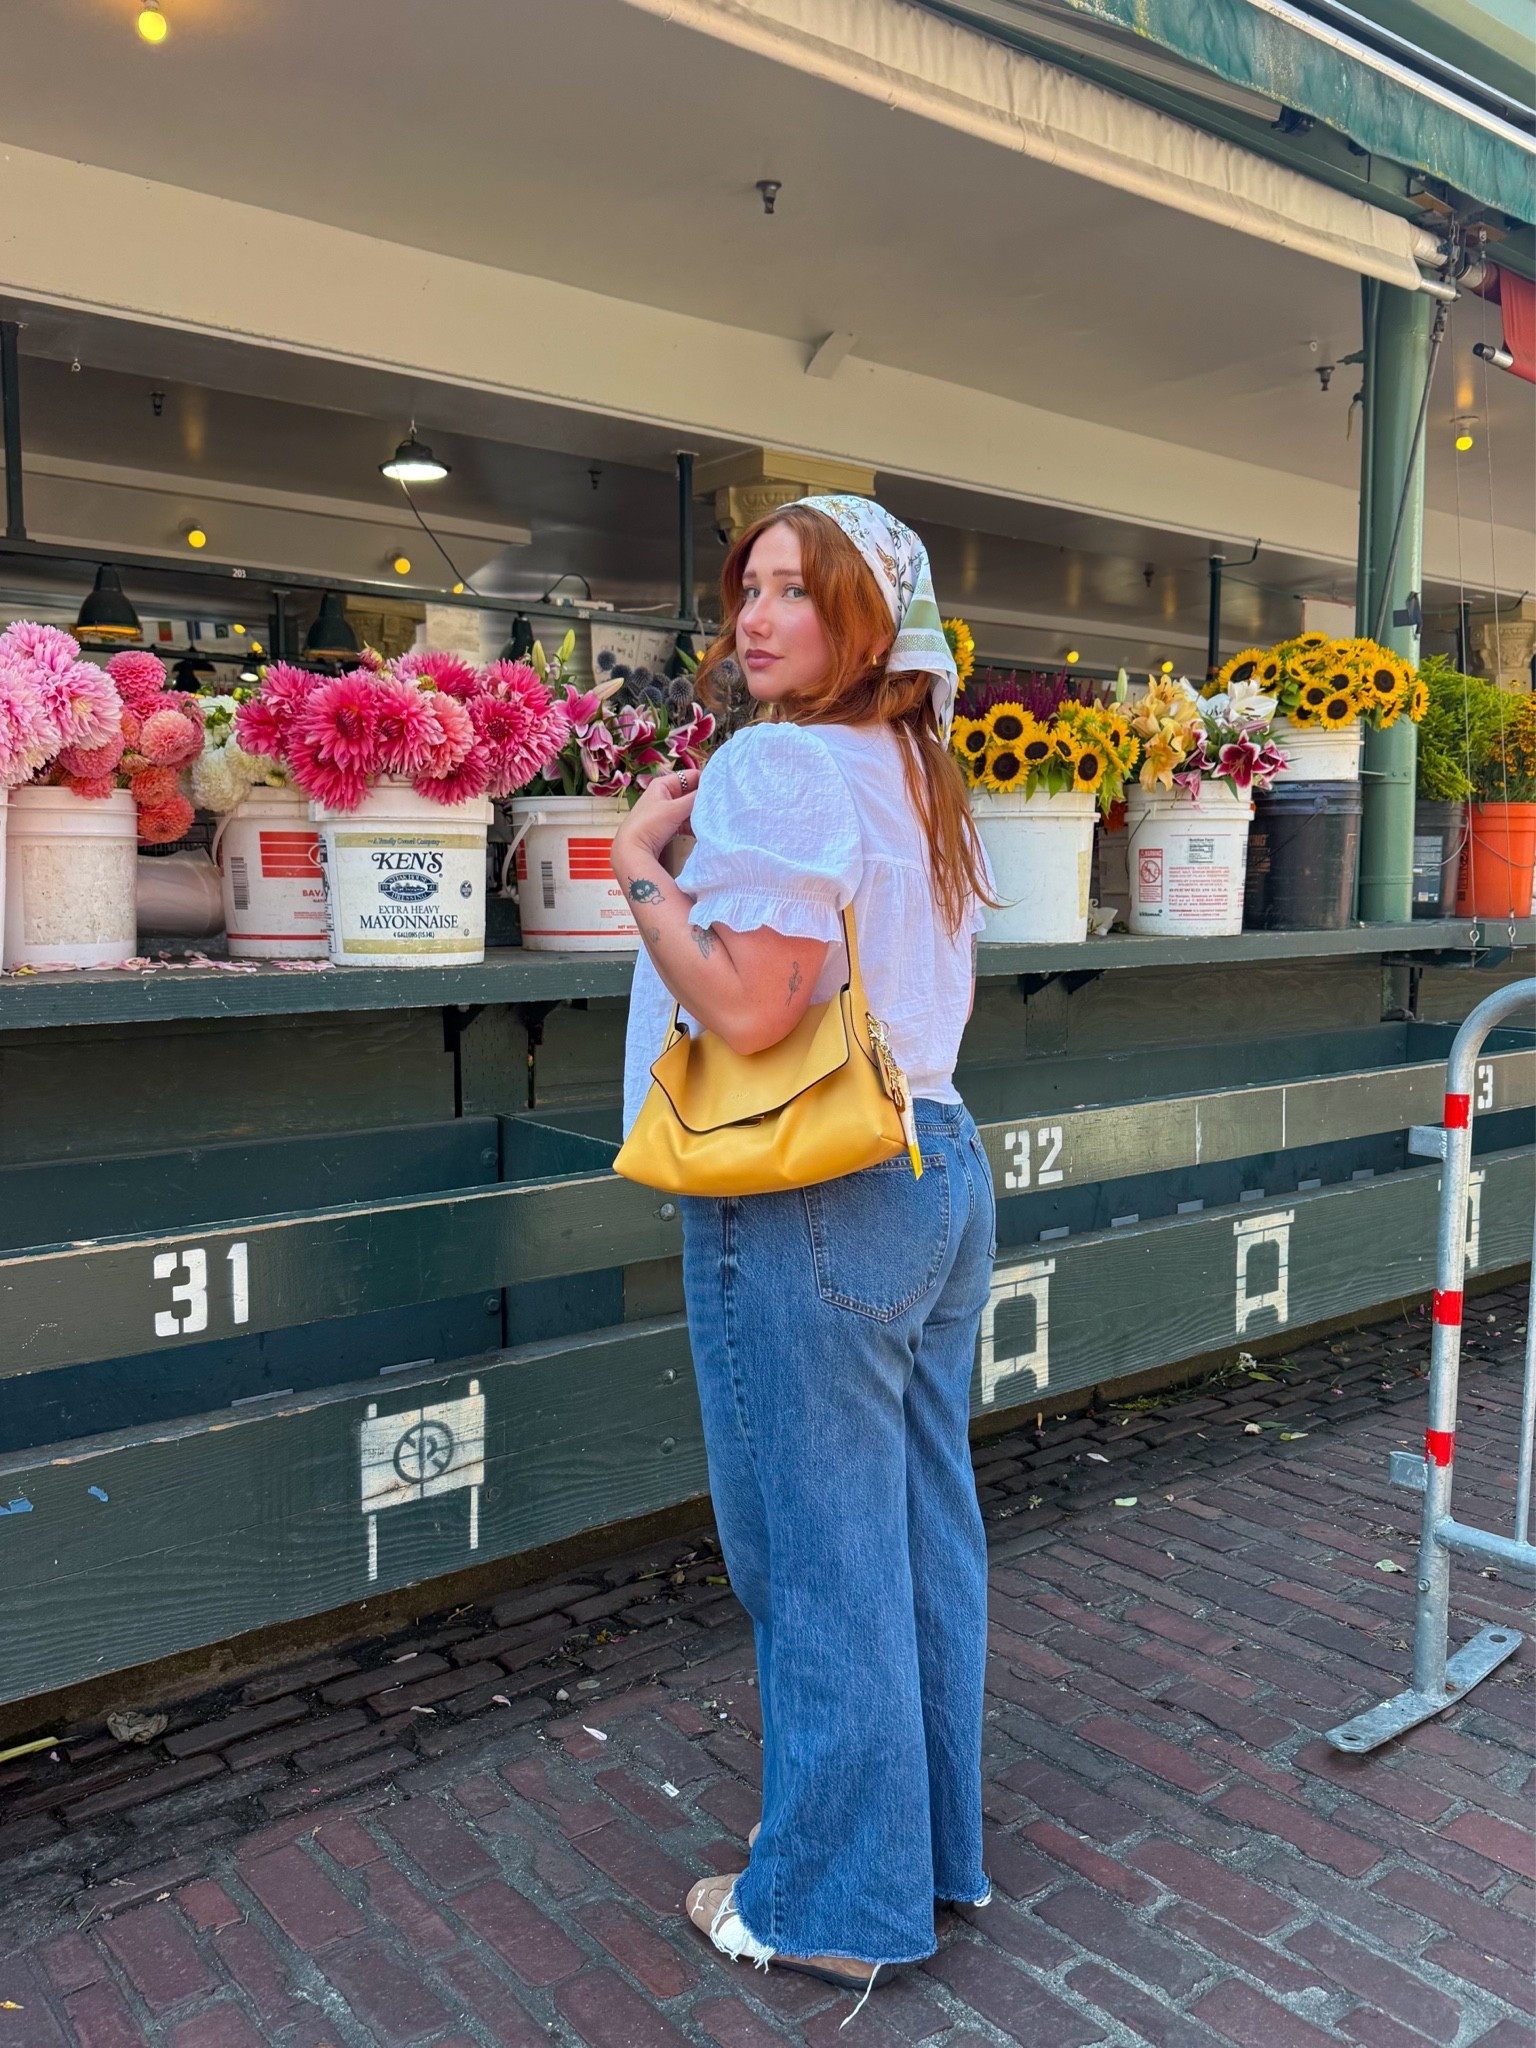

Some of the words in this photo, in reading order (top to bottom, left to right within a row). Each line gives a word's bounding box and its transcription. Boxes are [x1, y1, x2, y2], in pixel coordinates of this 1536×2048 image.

[232, 567, 247, 579] 203
[416, 837, 440, 846] Company
[371, 851, 443, 874] KEN'S
[378, 905, 409, 914] EXTRA
[411, 905, 440, 914] HEAVY
[360, 915, 459, 929] MAYONNAISE
[1005, 1126, 1063, 1189] 32
[154, 1242, 249, 1337] 31
